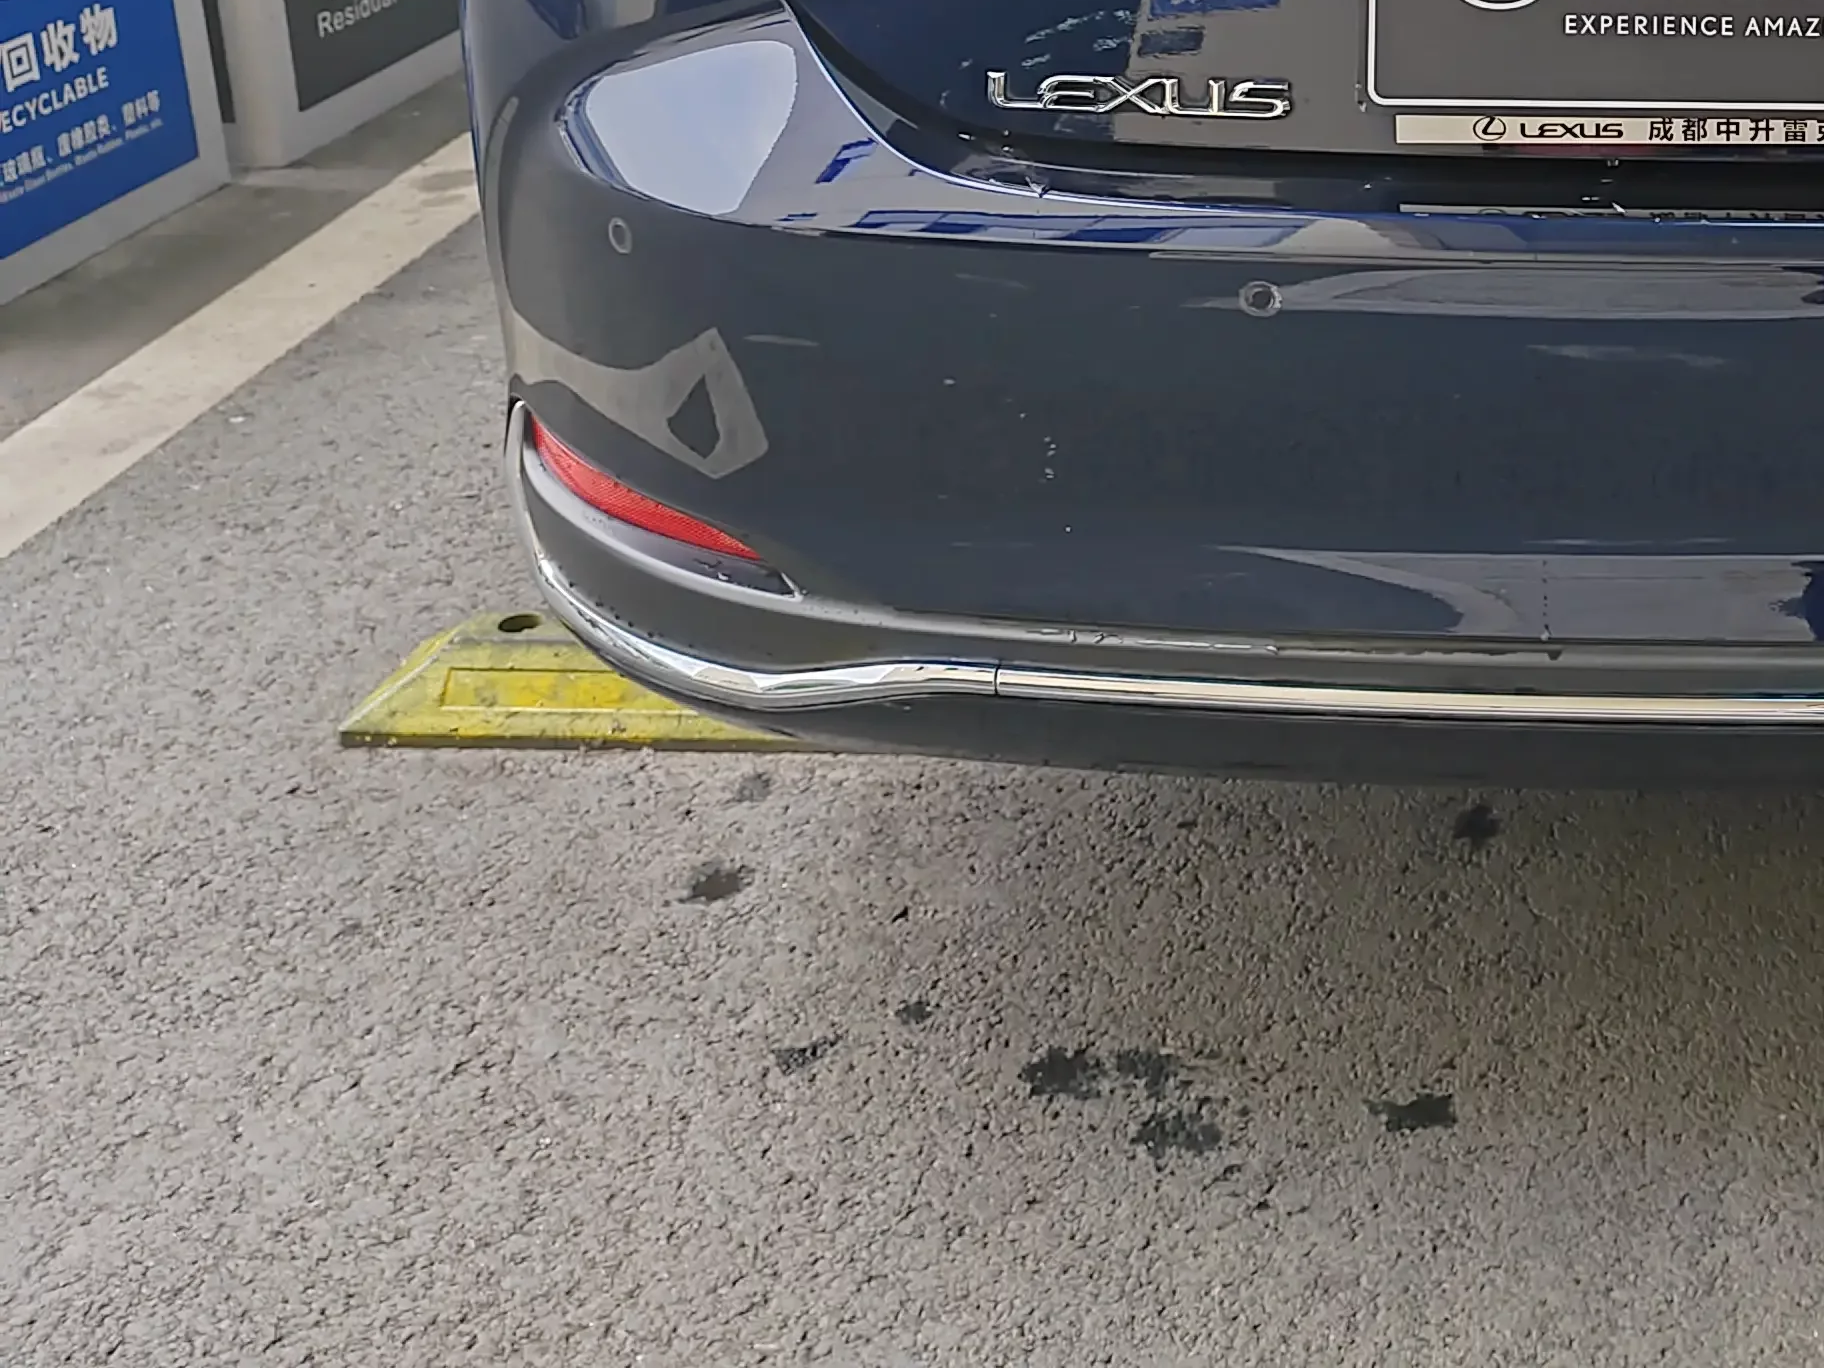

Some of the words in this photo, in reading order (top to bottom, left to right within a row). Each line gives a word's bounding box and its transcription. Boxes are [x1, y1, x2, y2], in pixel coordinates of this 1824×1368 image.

[0, 2, 119, 93] 回收物
[1564, 13, 1734, 37] EXPERIENCE
[0, 66, 110, 134] ECYCLABLE
[986, 70, 1292, 119] LEXUS
[1520, 123, 1624, 139] LEXUS
